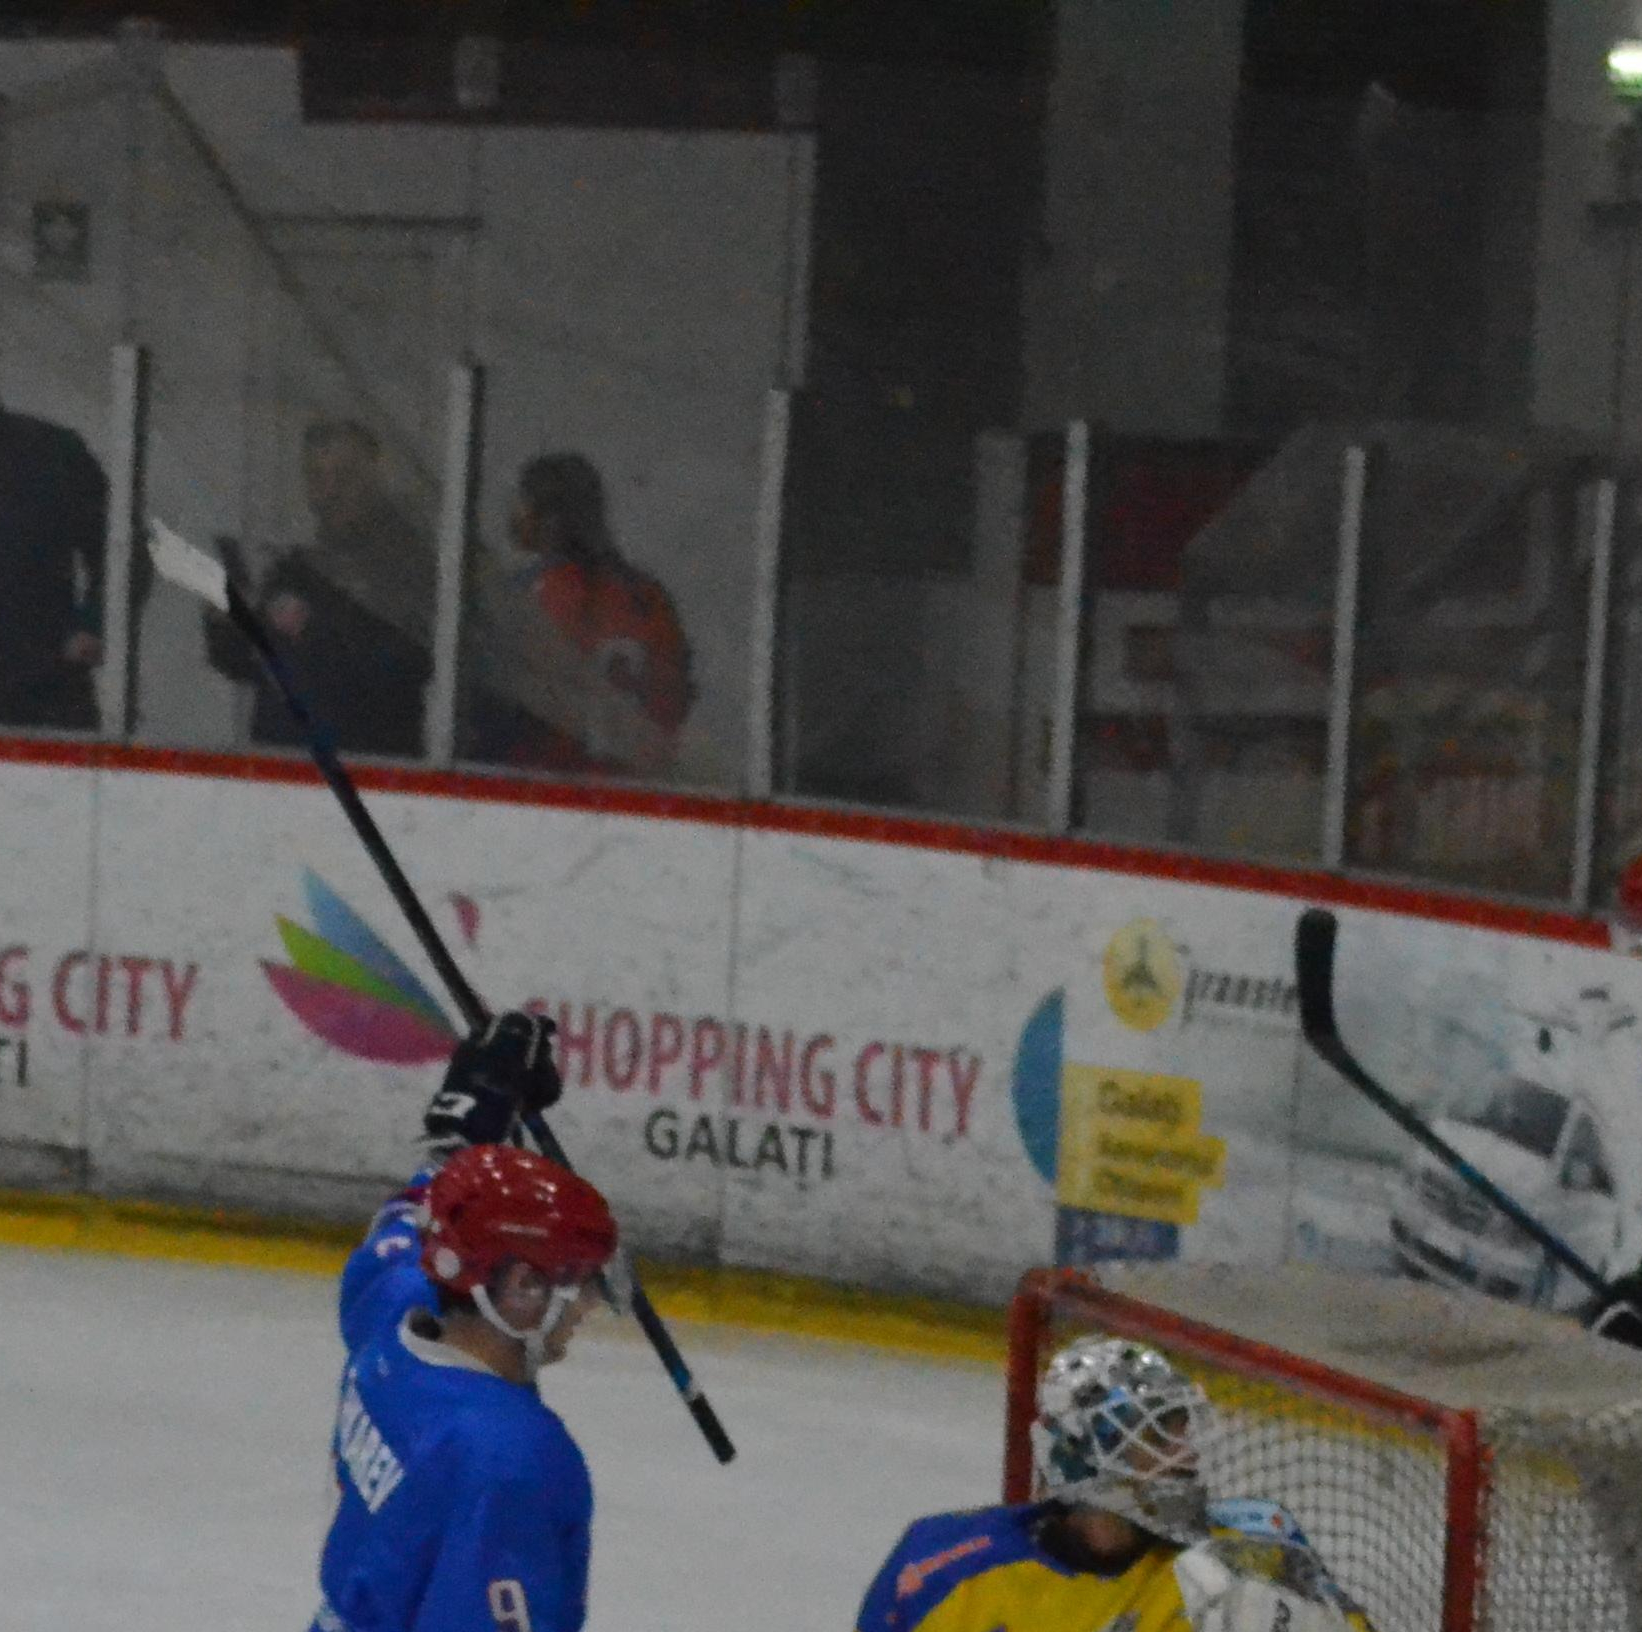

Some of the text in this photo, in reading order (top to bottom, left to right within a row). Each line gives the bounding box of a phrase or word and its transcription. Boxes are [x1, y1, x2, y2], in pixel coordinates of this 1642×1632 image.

[52, 949, 199, 1042] CITY
[523, 997, 837, 1119] HOPPING
[856, 1020, 983, 1137] CITY
